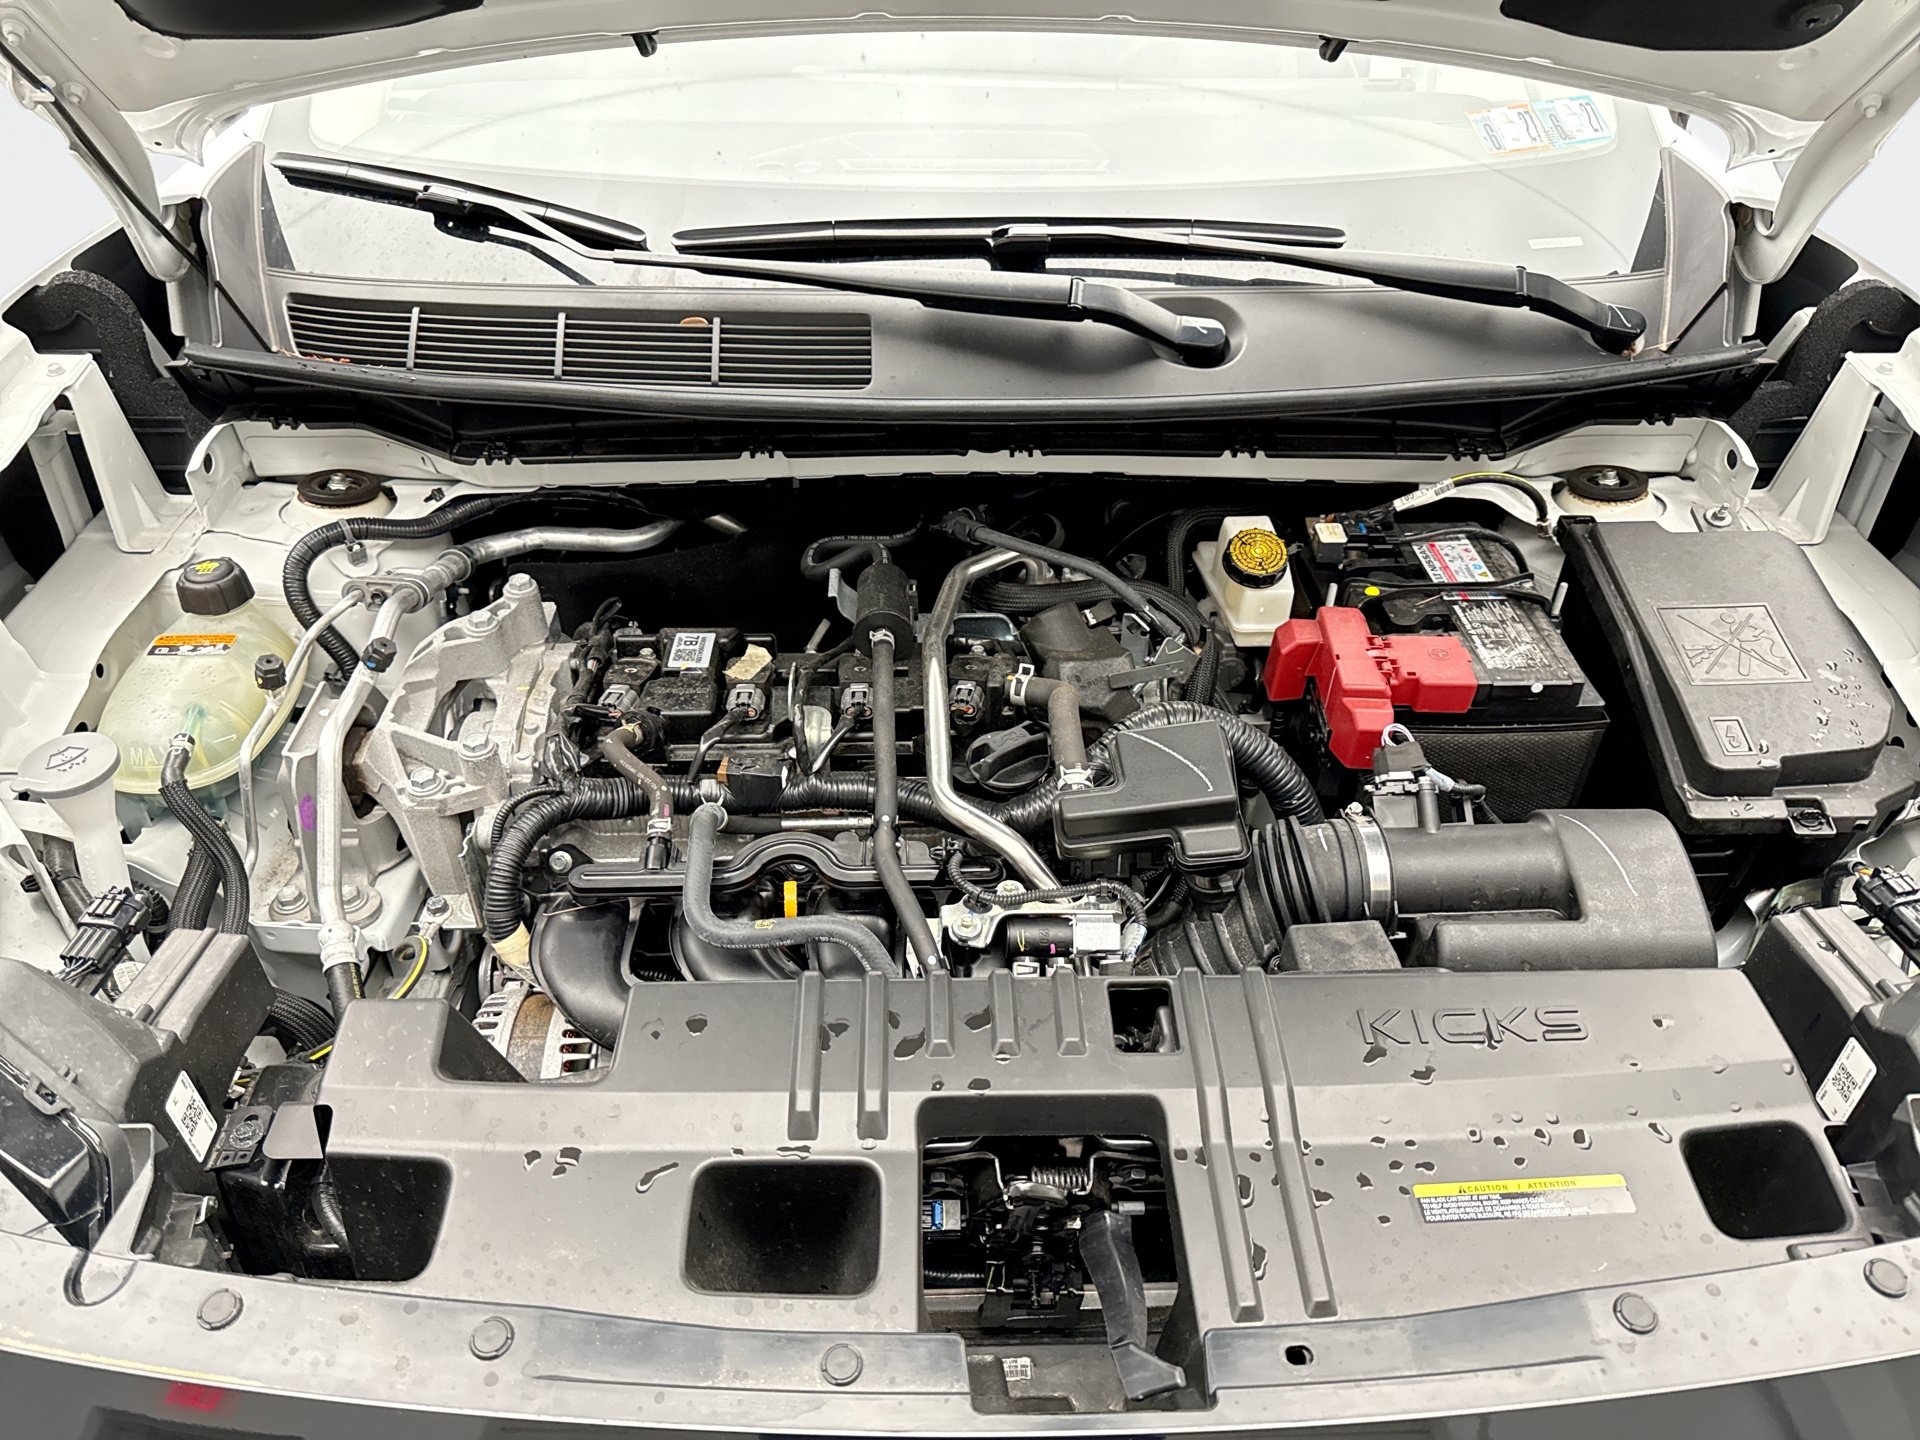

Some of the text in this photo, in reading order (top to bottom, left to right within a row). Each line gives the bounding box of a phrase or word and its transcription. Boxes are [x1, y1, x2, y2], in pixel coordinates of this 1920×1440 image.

[1549, 101, 1604, 141] 6 27
[1483, 123, 1502, 151] 6
[1416, 545, 1438, 572] NISSAN
[684, 635, 700, 647] 7B
[1356, 1005, 1589, 1045] KICKS
[1467, 1184, 1508, 1193] CAUTION
[1528, 1180, 1577, 1189] ATTENTION
